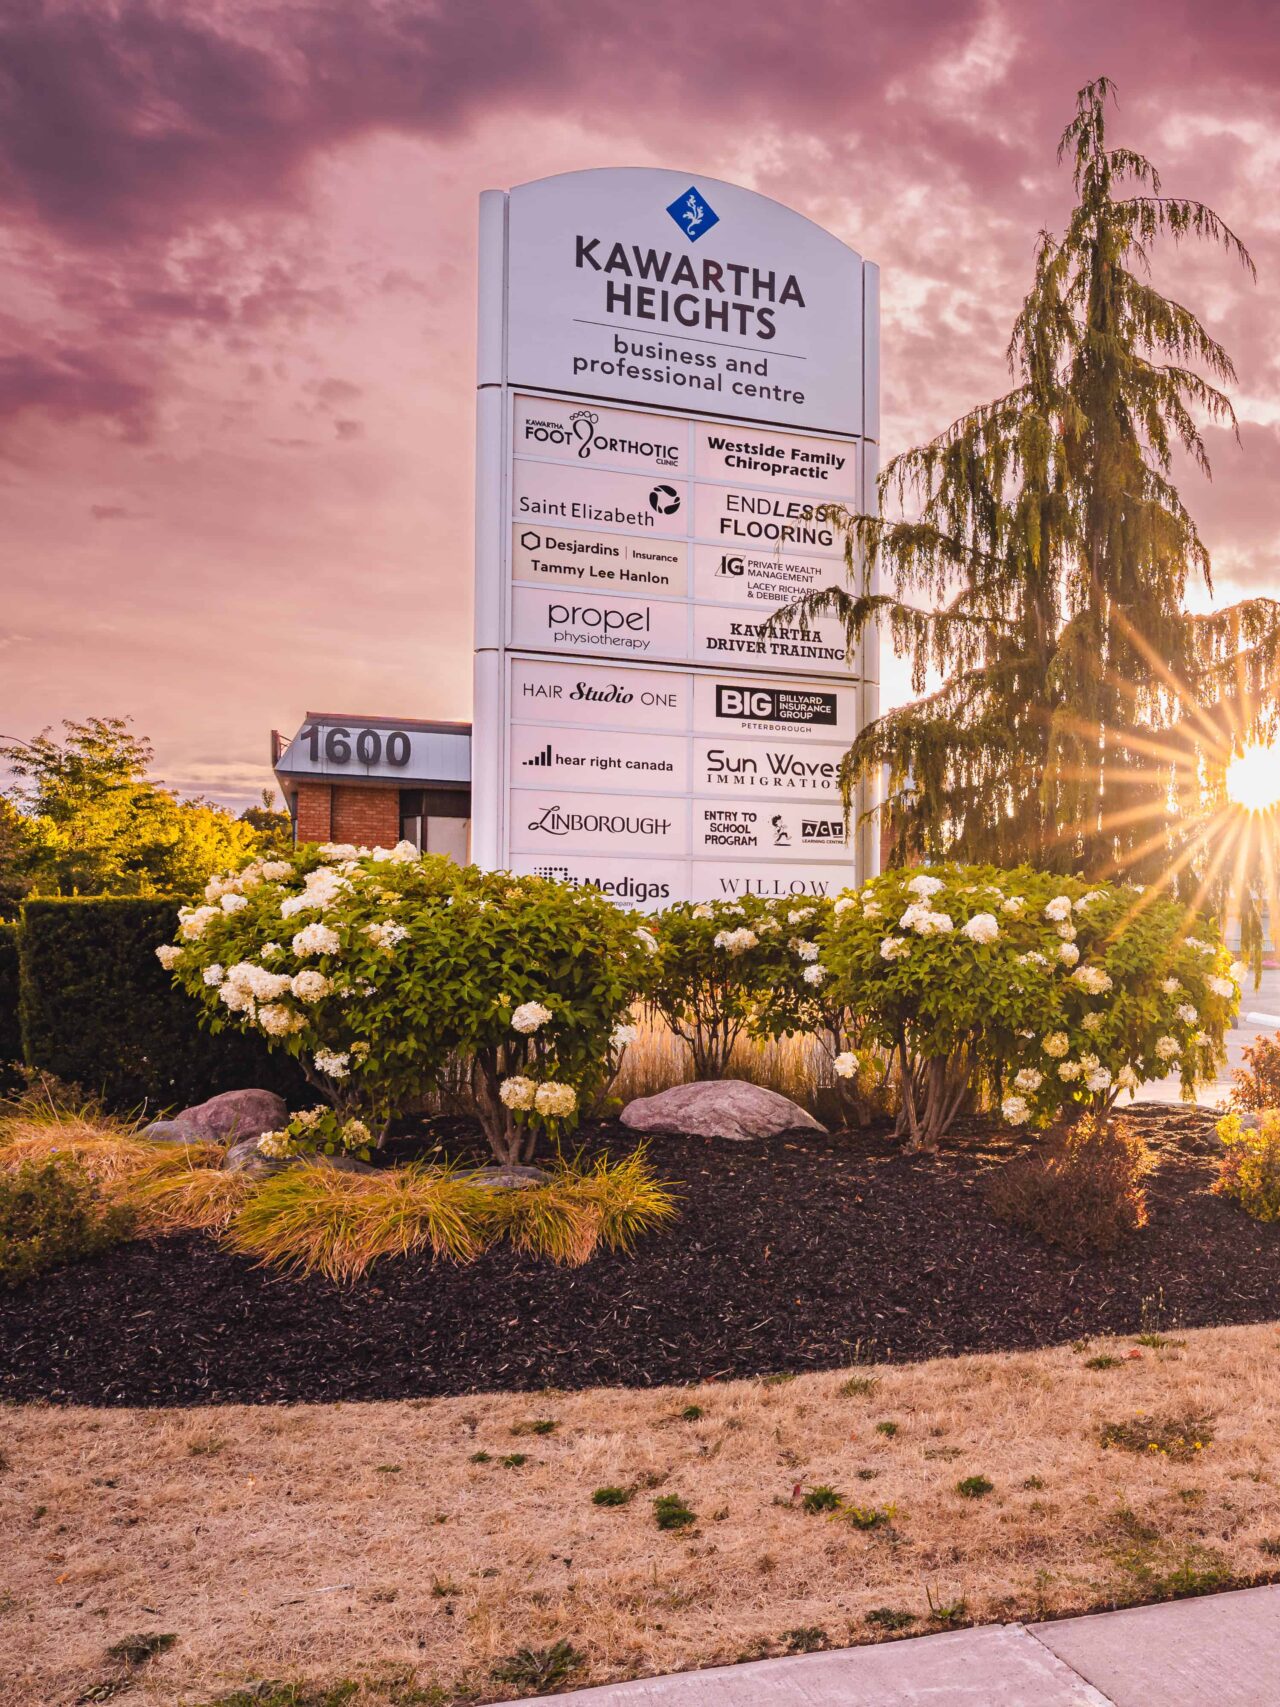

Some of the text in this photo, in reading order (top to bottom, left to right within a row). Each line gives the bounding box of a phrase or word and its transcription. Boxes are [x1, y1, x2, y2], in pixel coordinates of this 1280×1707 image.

[575, 235, 806, 307] KAWARTHA
[606, 280, 776, 339] HEIGHTS
[614, 334, 768, 377] business and
[573, 355, 805, 405] professional centre
[526, 419, 564, 430] KAWARTHA
[525, 426, 679, 460] FOOT ORTHOTIC
[707, 436, 845, 470] Westside Family
[656, 458, 679, 467] CLINIC
[724, 455, 828, 480] Chiropractic
[519, 496, 654, 527] Saint Elizabeth
[726, 494, 828, 523] ENDLESS
[720, 517, 833, 546] FLOORING
[545, 537, 678, 563] Desjardins Insurance
[531, 559, 669, 585] Tammy Lee Hanlon
[721, 555, 744, 576] IG
[747, 560, 822, 575] PRIVATE WEALTH
[747, 569, 814, 583] MANAGEMENT
[747, 581, 776, 592] LACEY
[747, 590, 754, 599] &
[756, 591, 789, 602] DEBBIE
[548, 604, 650, 633] propel
[554, 630, 651, 650] physiotherapy
[730, 623, 823, 643] KAWARTHA
[706, 637, 845, 660] DRIVER TRAINING
[523, 681, 677, 707] HAIR Studio ONE
[721, 689, 772, 717] BIG
[779, 694, 823, 705] BILLYARD
[779, 703, 832, 714] INSURANCE
[779, 711, 813, 720] GROUP
[741, 722, 812, 733] PETERBOROUGH
[300, 725, 411, 767] 1600
[555, 753, 674, 772] hear right canada
[707, 750, 757, 774] Sun
[704, 810, 757, 822] ENTRY TO
[710, 823, 751, 834] SCHOOL
[803, 823, 842, 836] ACT
[704, 835, 757, 846] PROGRAM
[719, 878, 829, 896] WILLOW
